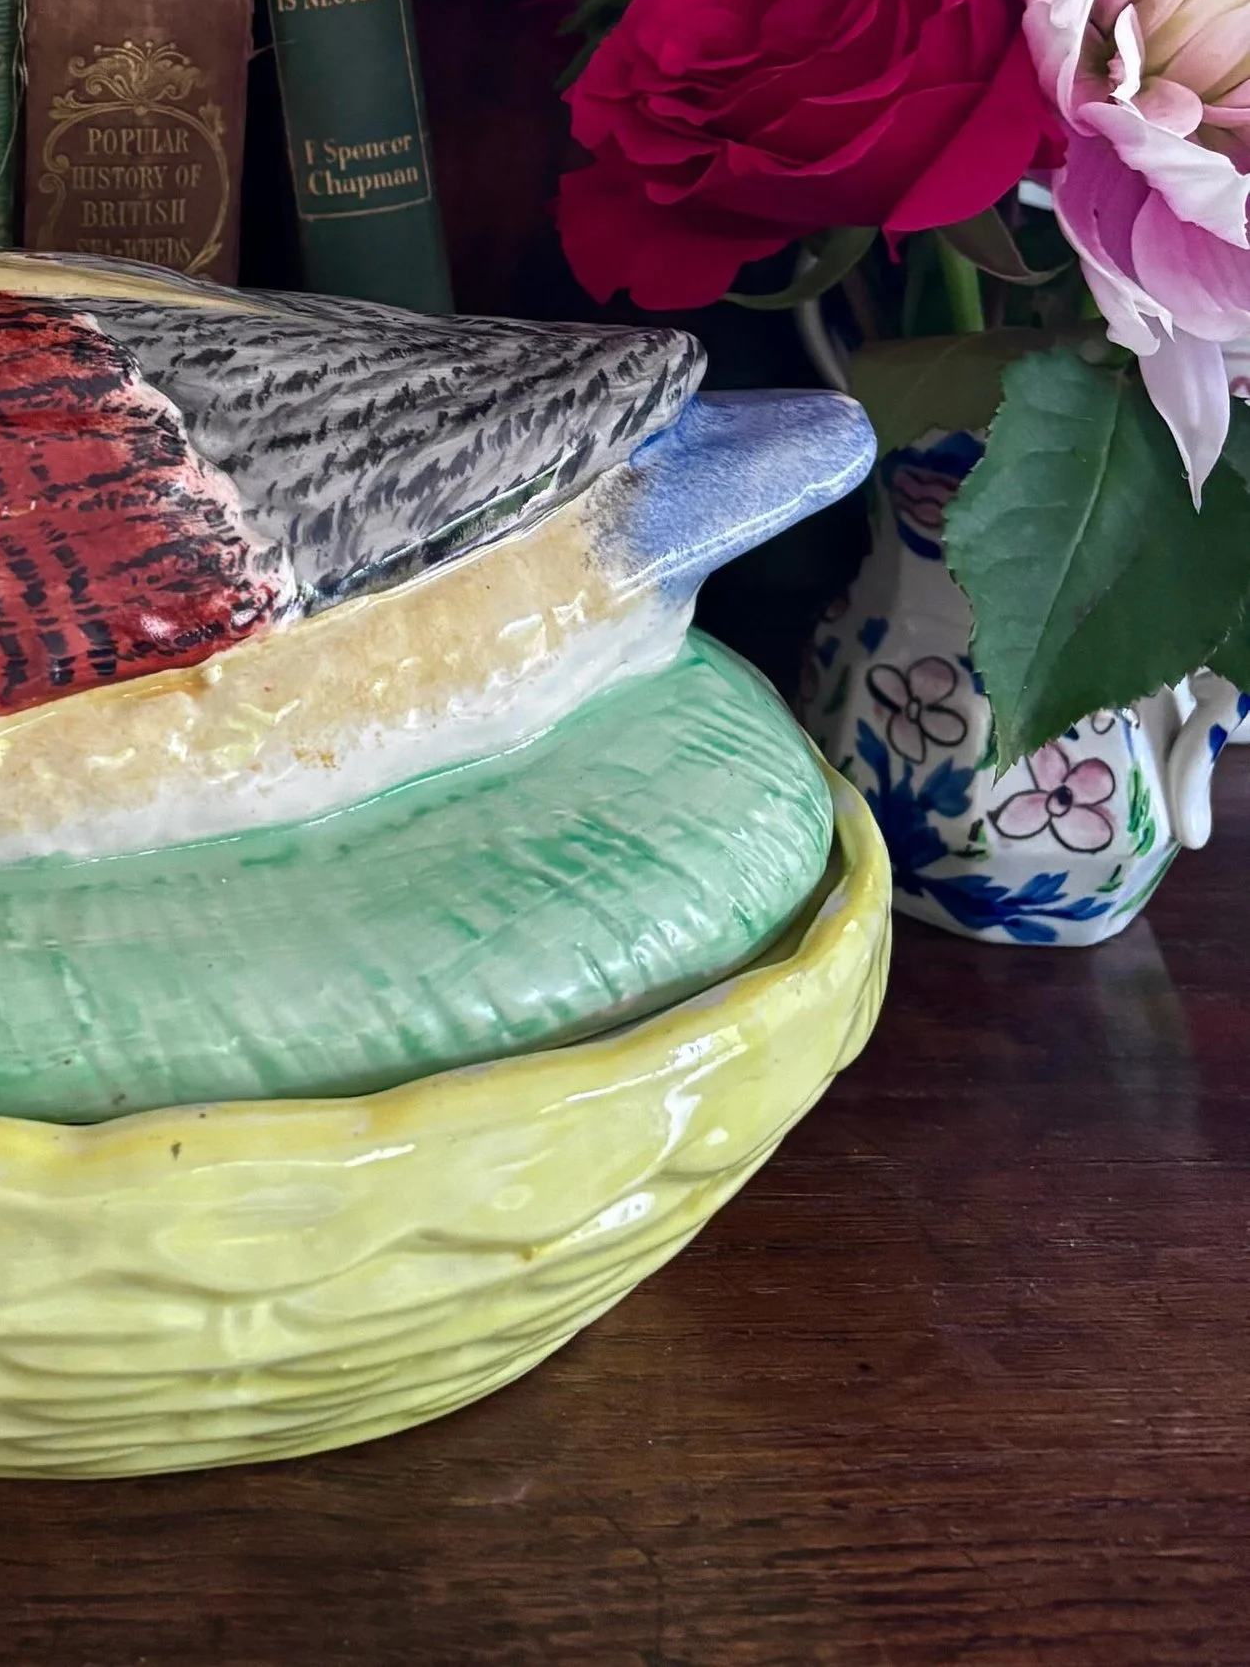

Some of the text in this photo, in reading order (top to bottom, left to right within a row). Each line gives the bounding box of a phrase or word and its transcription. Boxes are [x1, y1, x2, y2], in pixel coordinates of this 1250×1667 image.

[84, 127, 190, 156] POPULAR
[323, 134, 414, 172] Spencer
[71, 163, 203, 190] HISTORY OF
[307, 165, 420, 200] Chapman
[80, 197, 187, 228] BRITISH
